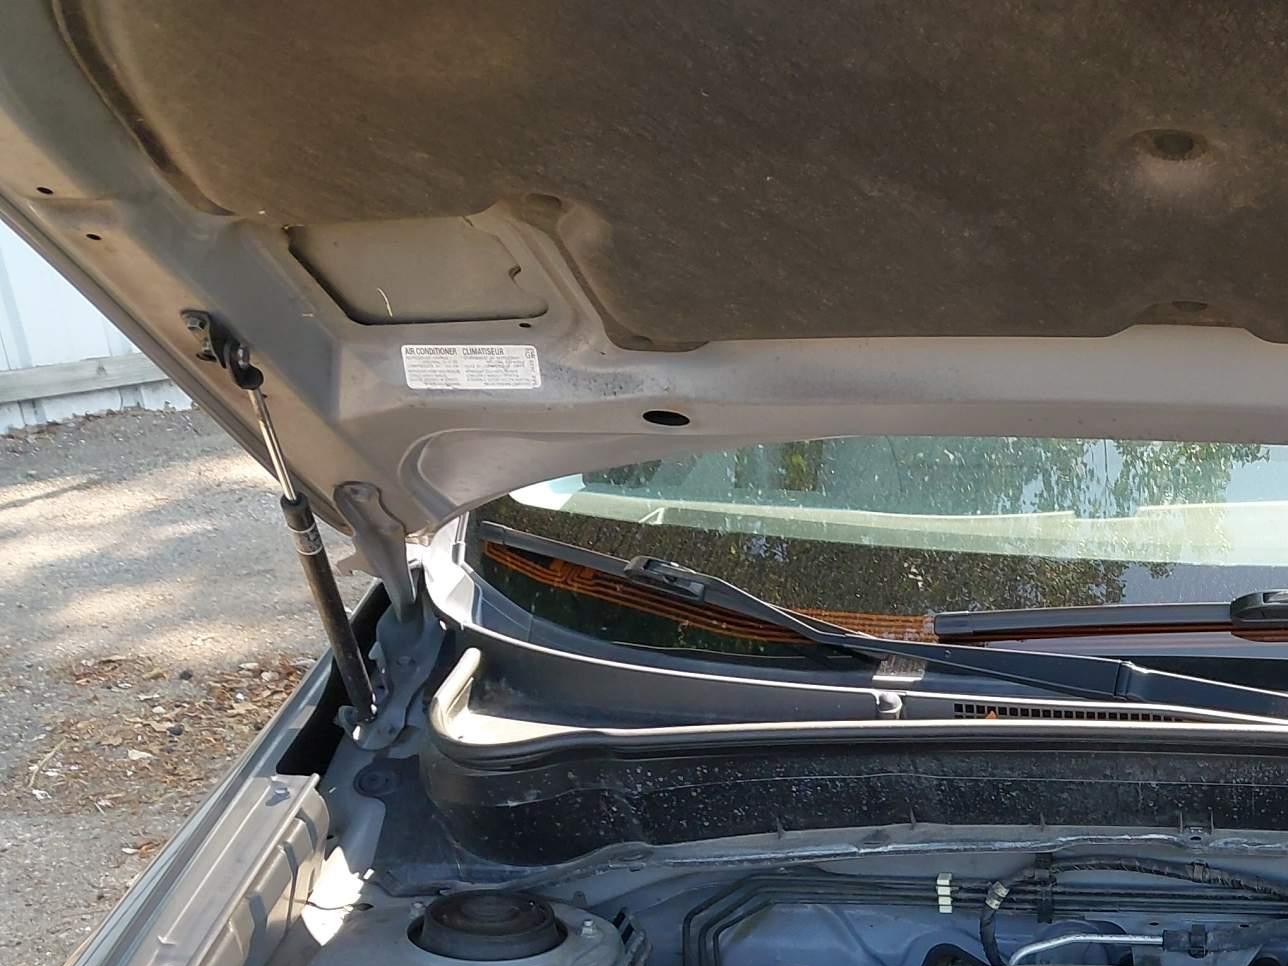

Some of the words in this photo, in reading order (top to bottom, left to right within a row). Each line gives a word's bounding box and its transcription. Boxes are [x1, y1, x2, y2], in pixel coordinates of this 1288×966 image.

[405, 347, 415, 355] AIR
[416, 347, 457, 356] CONDITIONER
[462, 347, 504, 356] CLIMATISEUR
